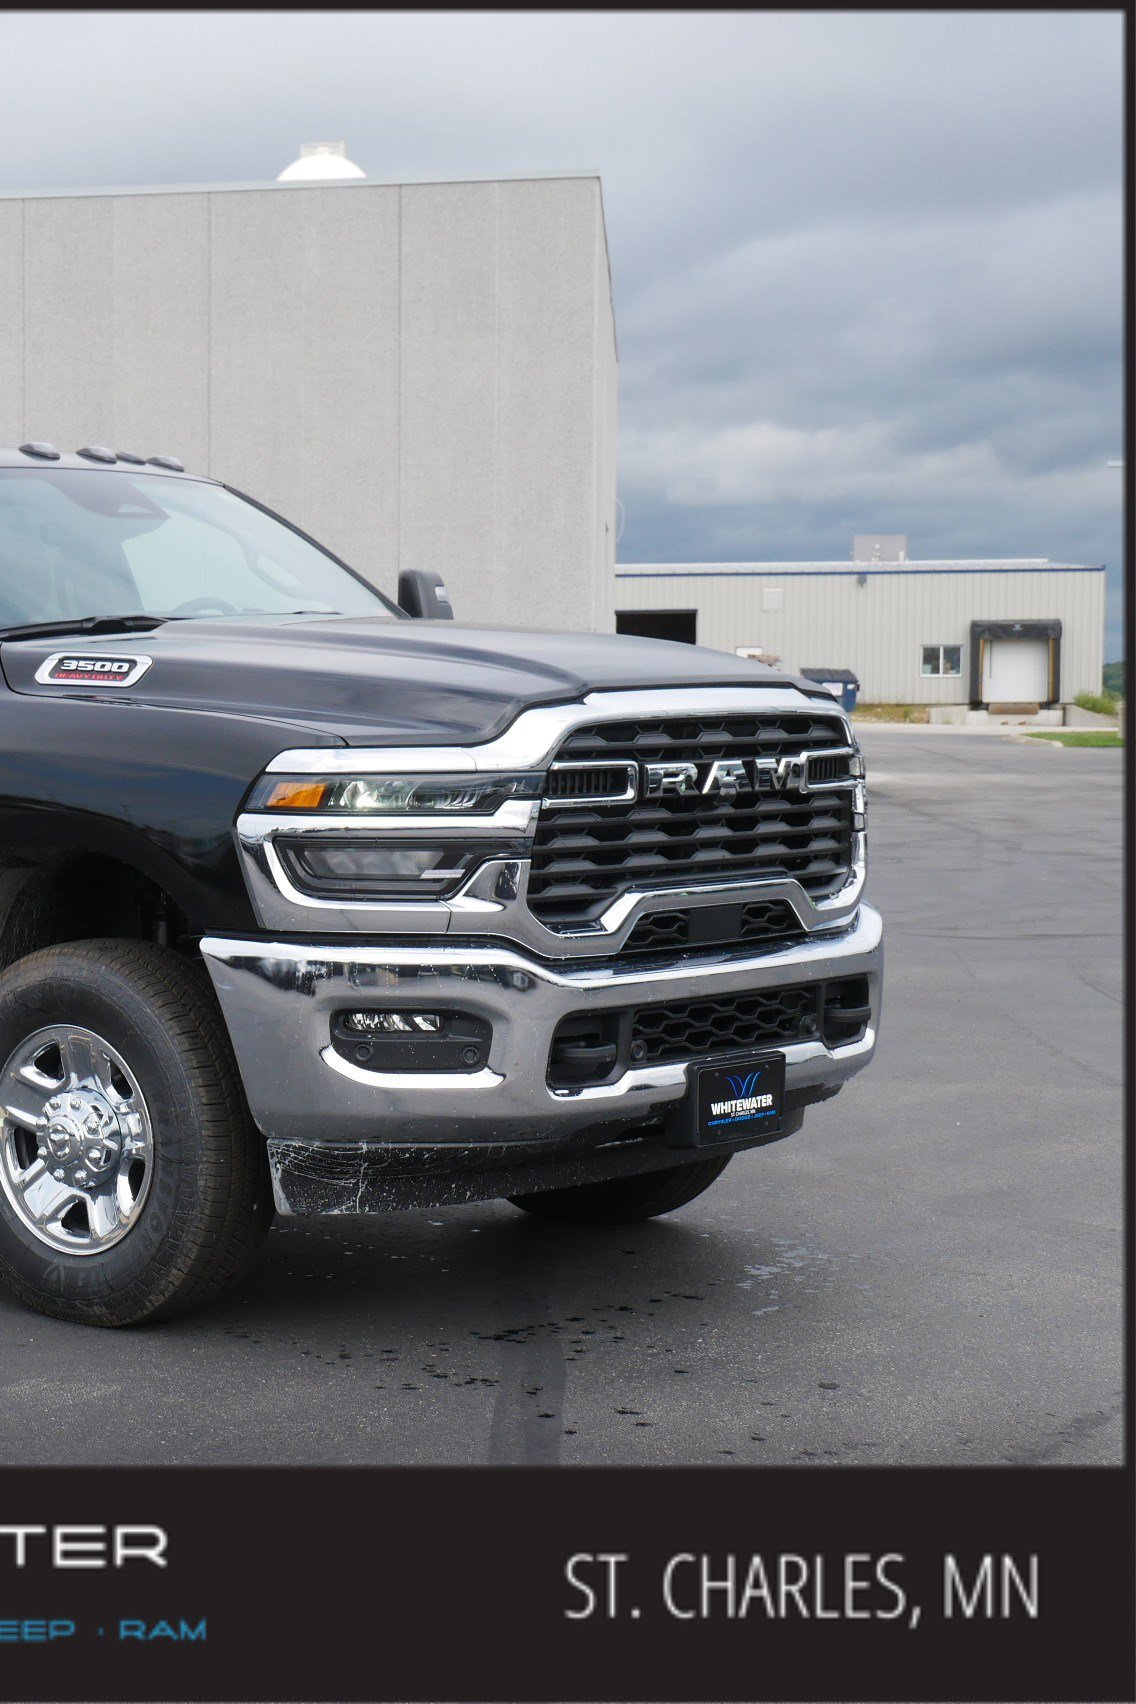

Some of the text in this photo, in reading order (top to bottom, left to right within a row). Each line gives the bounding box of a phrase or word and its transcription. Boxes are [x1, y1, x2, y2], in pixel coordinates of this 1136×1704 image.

[60, 659, 130, 673] 3500
[645, 757, 802, 797] RAM
[711, 1094, 773, 1115] WHITEWATER
